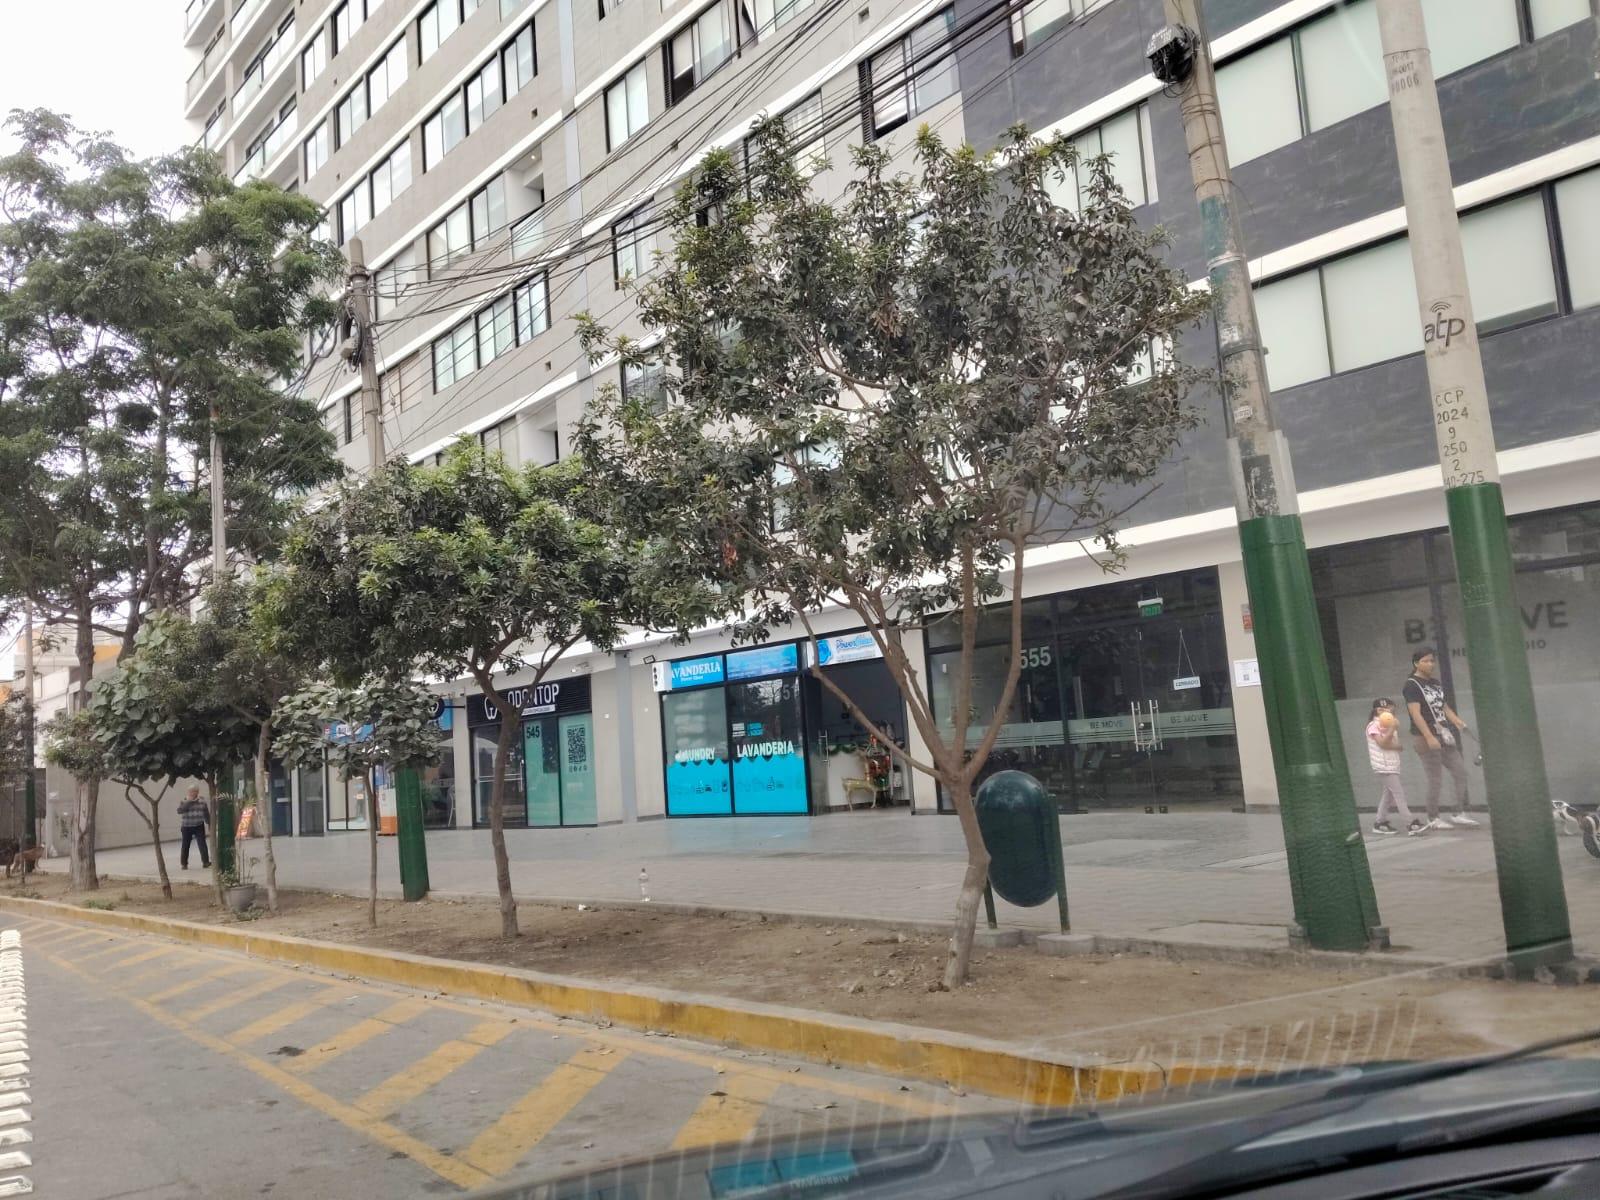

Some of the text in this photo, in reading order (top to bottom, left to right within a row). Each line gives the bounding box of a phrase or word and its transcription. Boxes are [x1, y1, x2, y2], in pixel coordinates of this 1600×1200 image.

[1424, 312, 1465, 347] atp
[1435, 389, 1463, 407] CCP
[1436, 406, 1469, 424] 2024
[1448, 427, 1456, 439] 9
[1443, 441, 1468, 457] 250
[1452, 459, 1461, 471] 2
[1520, 600, 1569, 630] VE
[1020, 646, 1051, 669] 555
[672, 661, 721, 679] AVANDERIA
[526, 726, 540, 738] 545
[675, 747, 715, 761] AUNDRY
[736, 740, 794, 758] LAVANDERIA
